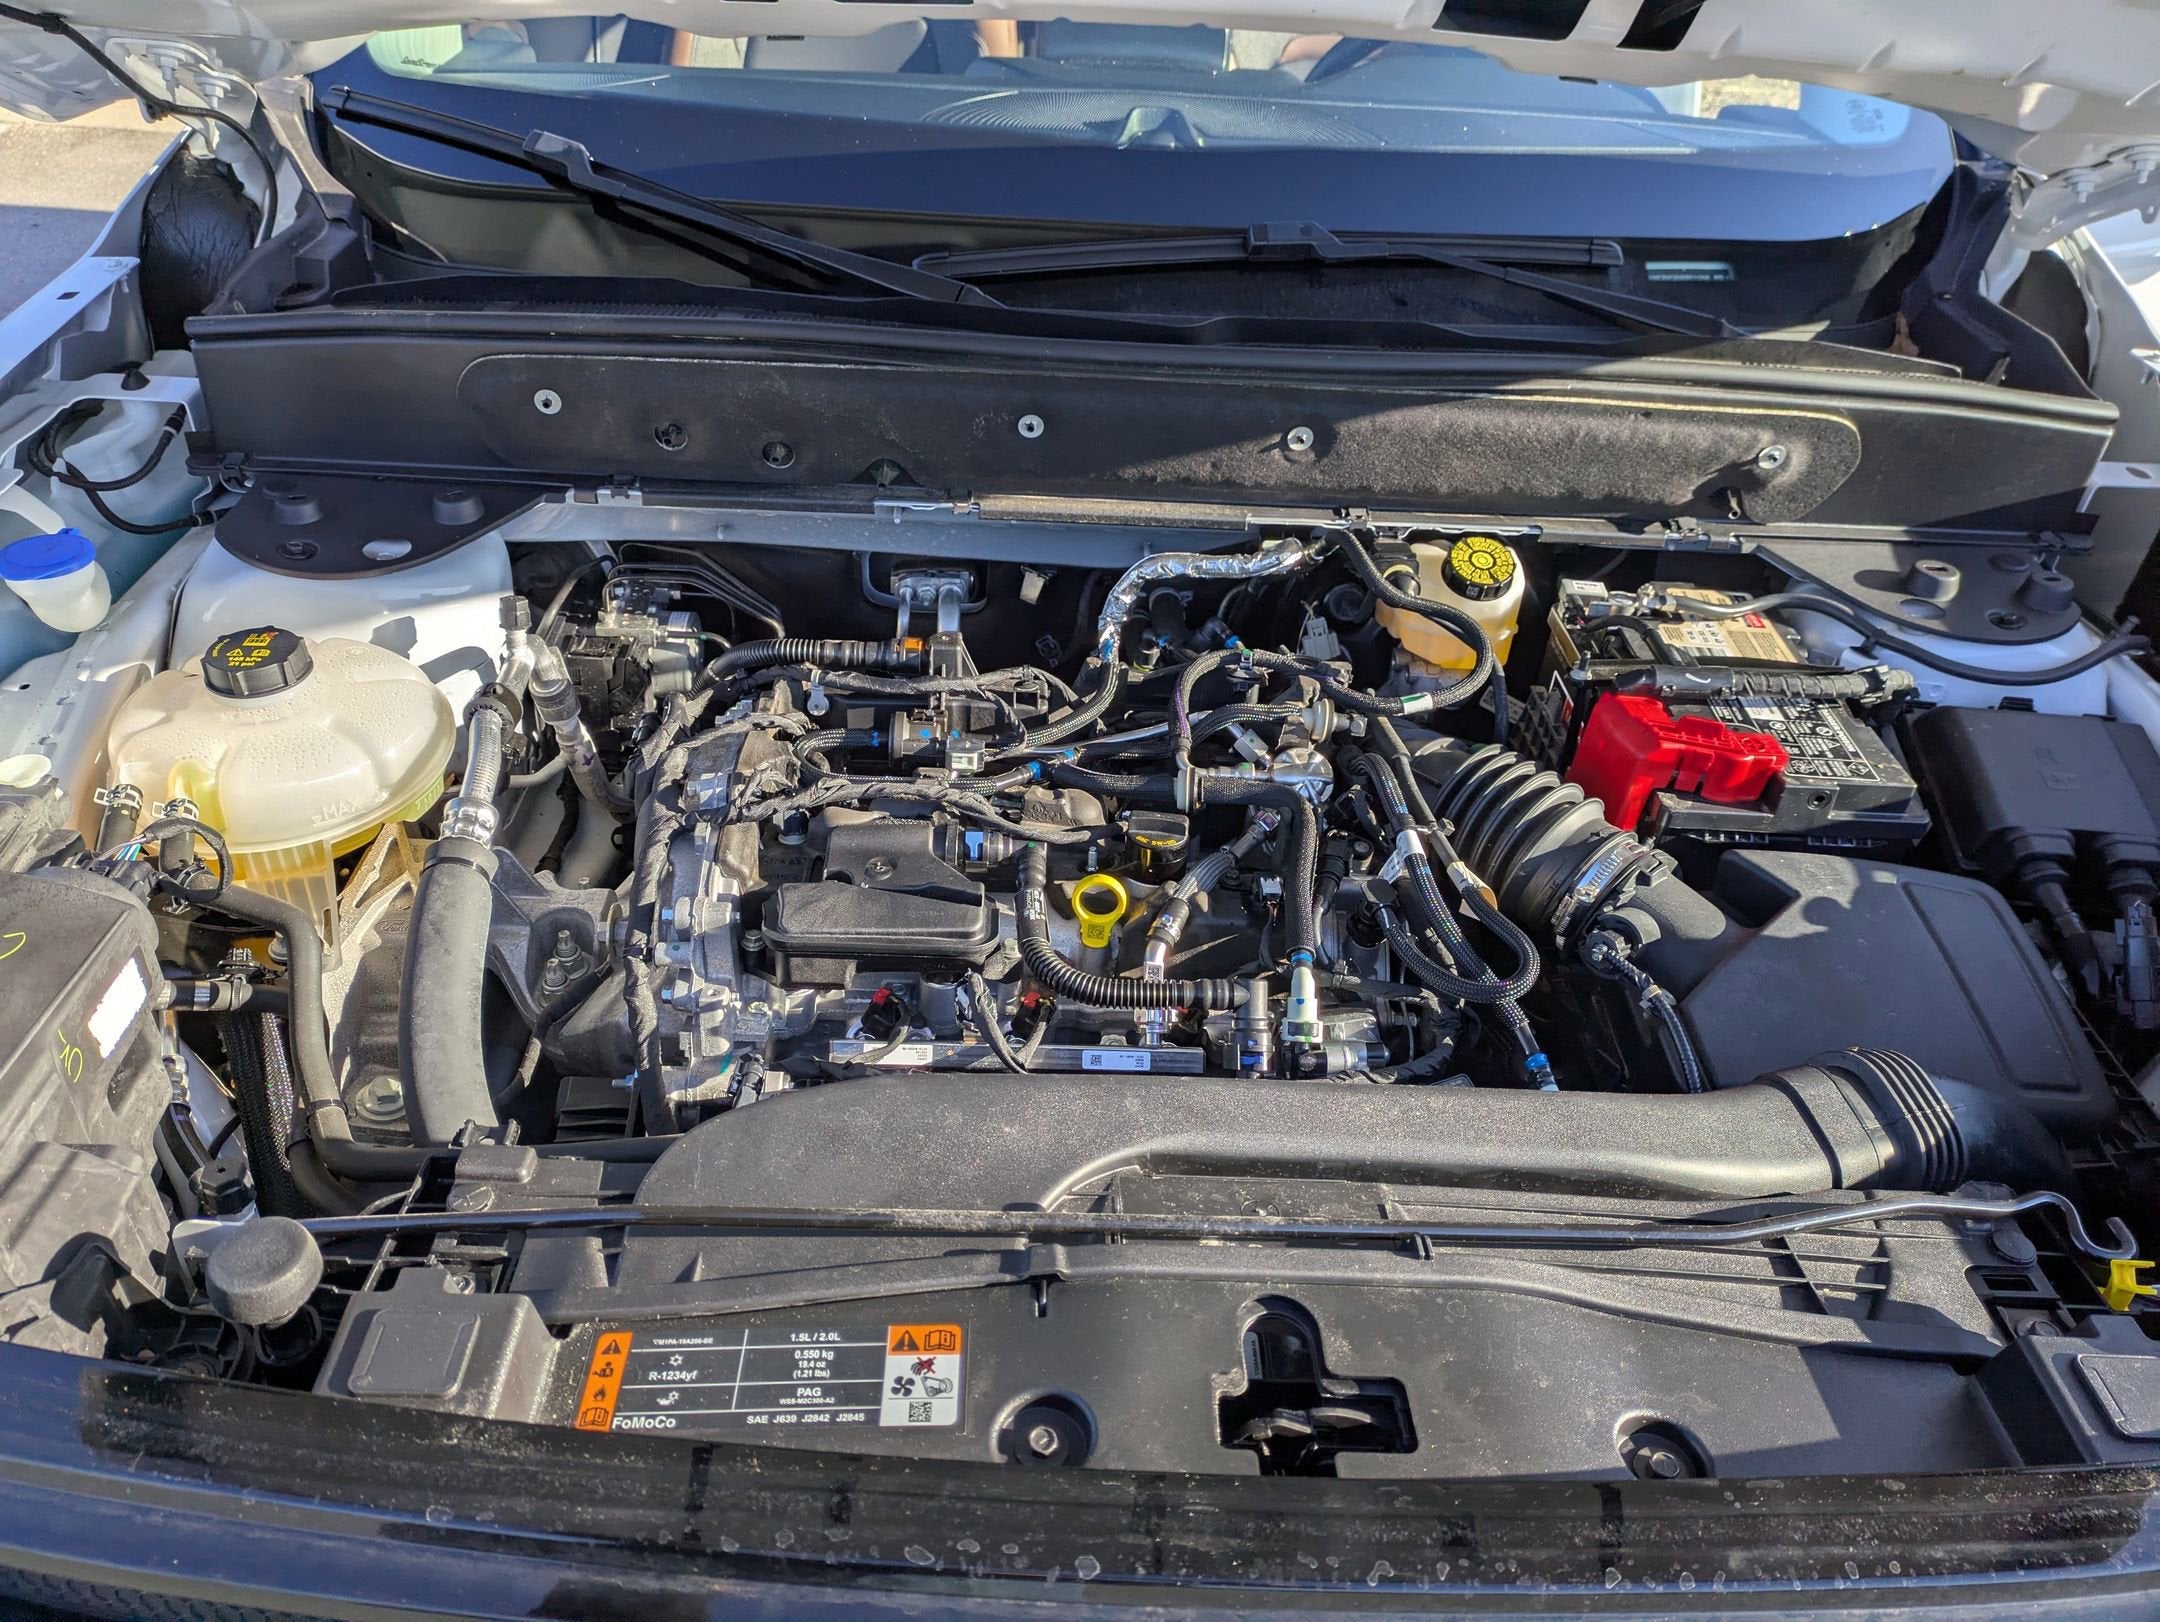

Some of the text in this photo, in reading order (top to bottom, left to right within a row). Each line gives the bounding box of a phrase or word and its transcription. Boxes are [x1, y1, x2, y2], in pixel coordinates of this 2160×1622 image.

[321, 800, 364, 820] MAX
[790, 1332, 812, 1342] 1.5L
[819, 1332, 841, 1341] 2.0L
[794, 1350, 834, 1360] 0.550 kg
[648, 1370, 699, 1381] R-1234yf
[793, 1369, 830, 1379] (1.21 lbs)
[797, 1387, 822, 1397] PAG
[612, 1416, 676, 1429] FoMoCo
[747, 1413, 865, 1424] SAE J639 J2842 J2845
